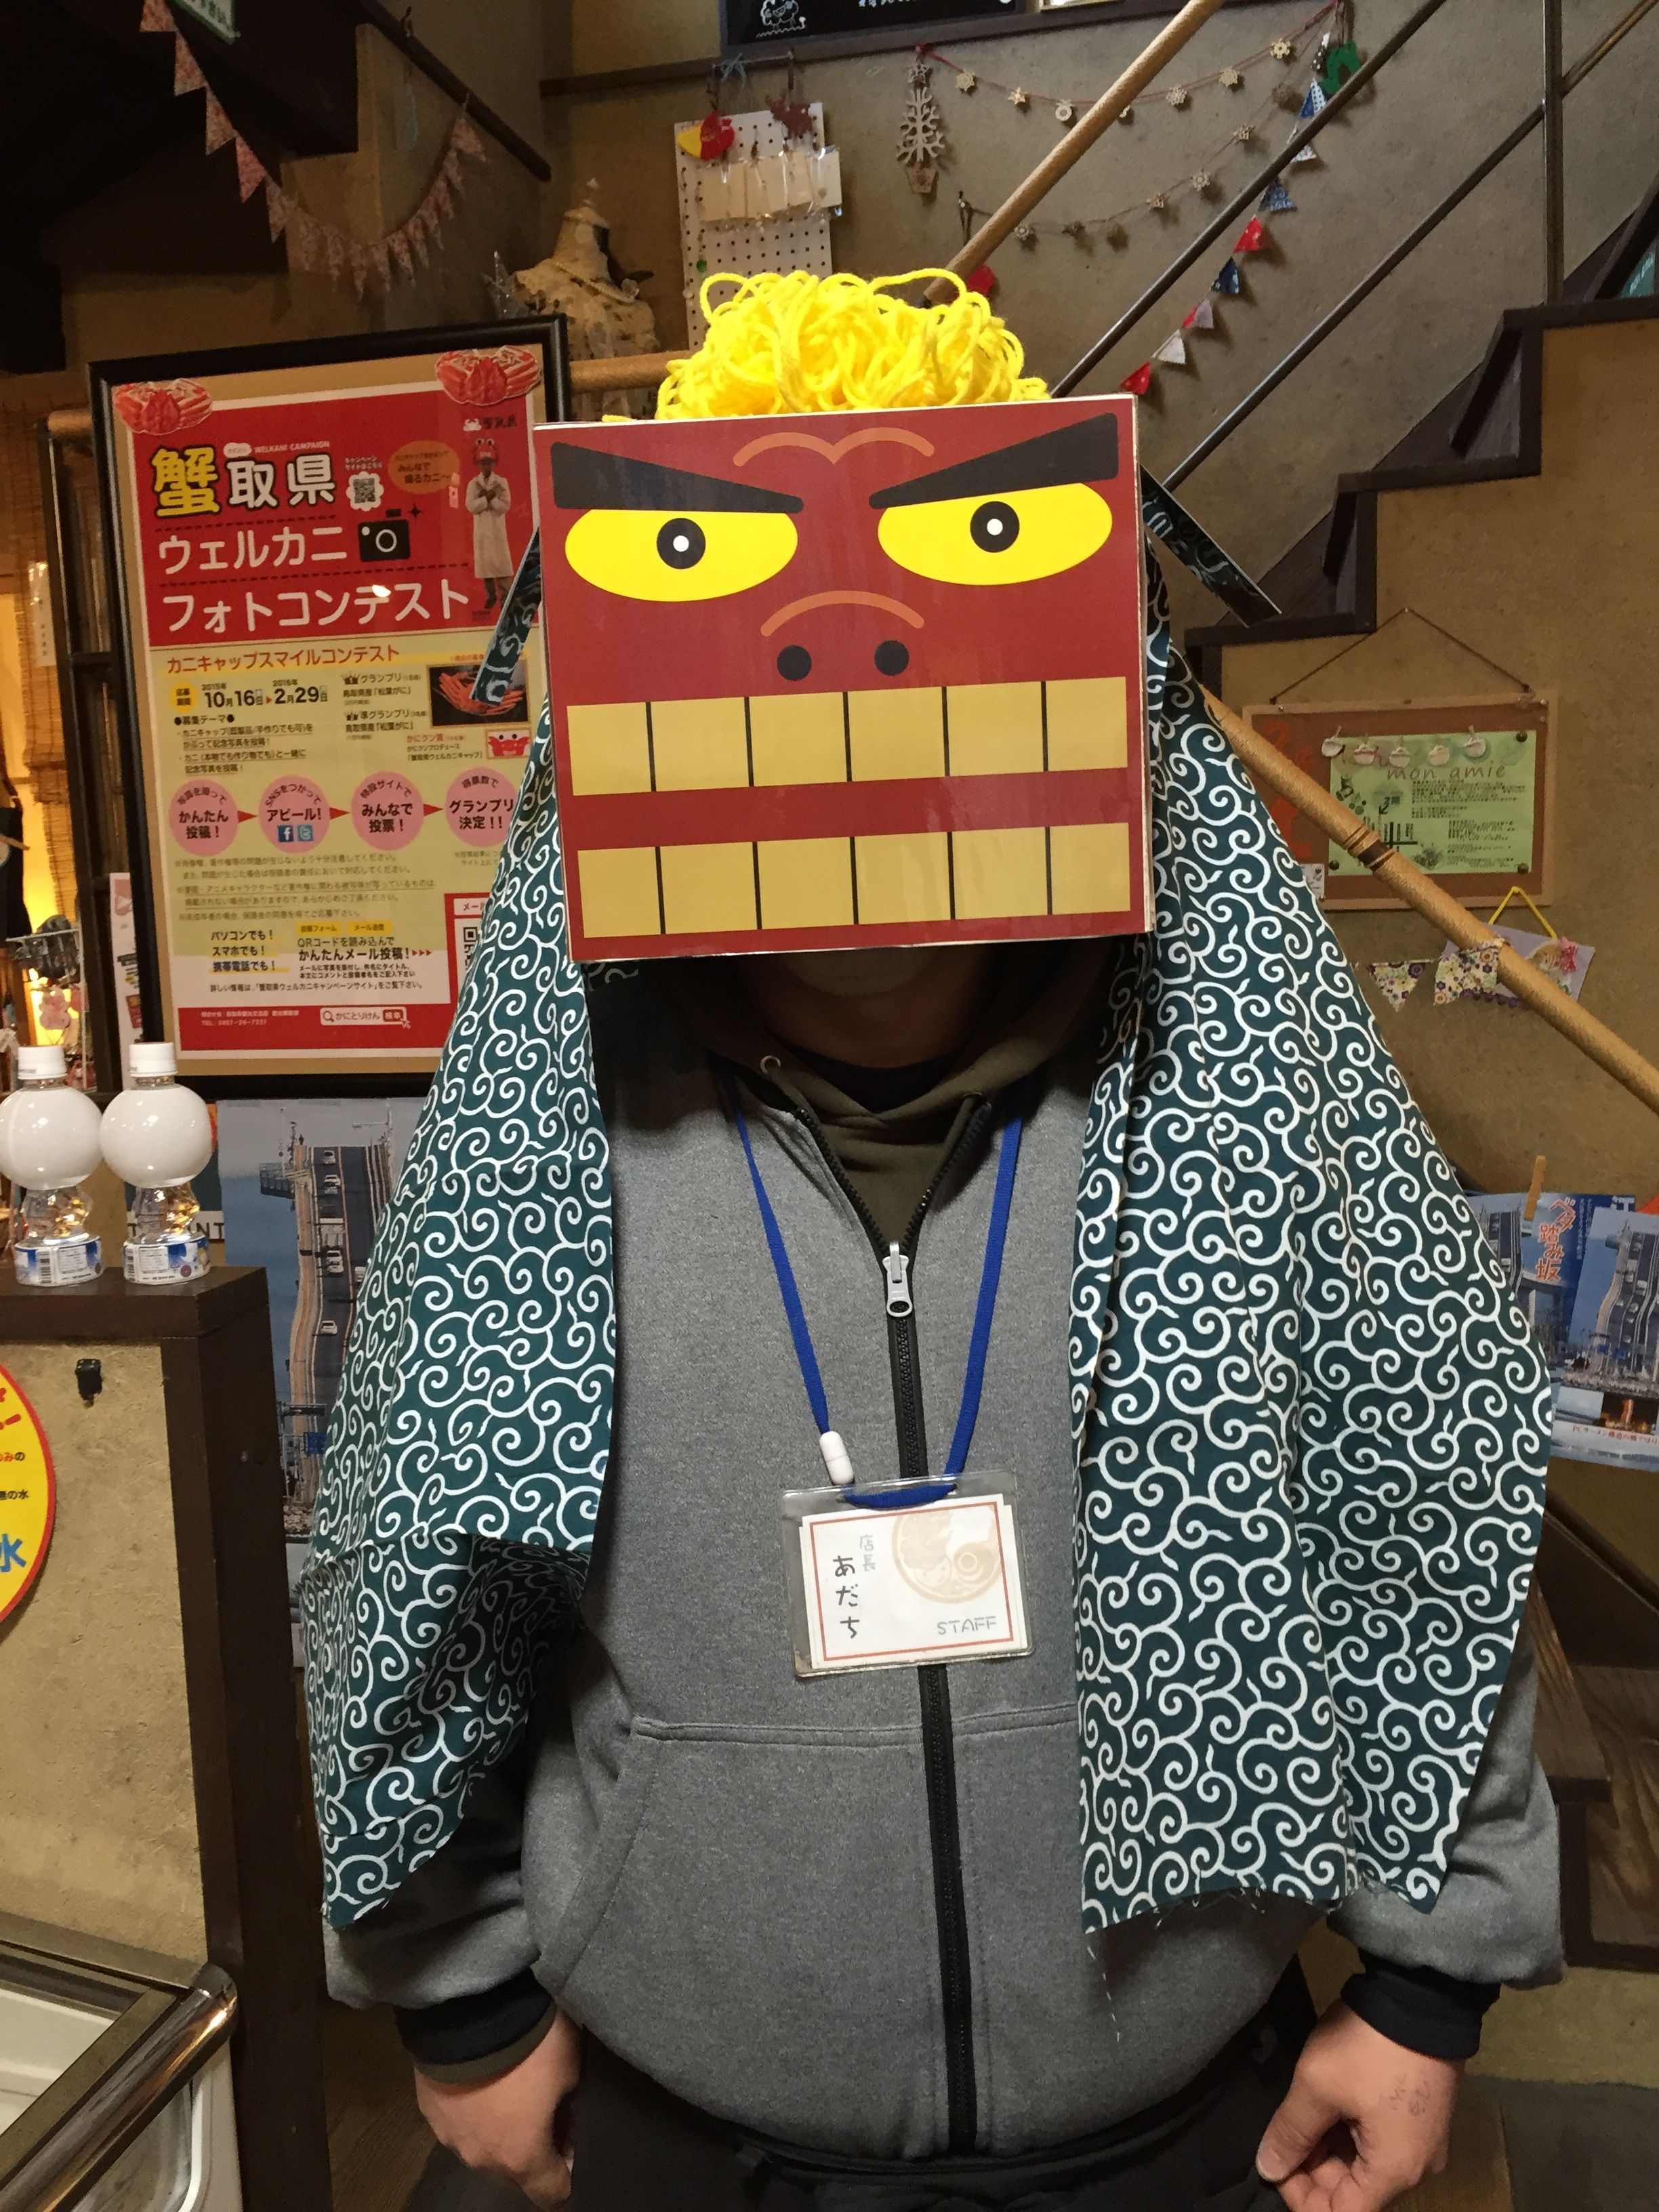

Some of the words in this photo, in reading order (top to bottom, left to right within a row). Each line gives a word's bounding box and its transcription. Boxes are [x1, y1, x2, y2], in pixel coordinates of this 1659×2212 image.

[150, 444, 337, 518] 蟹取県
[159, 525, 348, 574] ウェルカニ
[162, 577, 469, 632] フォトコンテスト
[167, 646, 400, 674] カニキャップスマイルコンテスト
[1387, 767, 1436, 780] mon
[1450, 760, 1506, 779] amie
[265, 783, 322, 808] SNSをつかって
[449, 798, 514, 814] グランプリ
[179, 810, 228, 823] かんたん
[361, 803, 413, 818] みんなで
[298, 937, 394, 947] QRコードを読み込んで
[1535, 1196, 1577, 1282] ベタ踏み坂
[859, 1534, 876, 1572] 店長
[833, 1555, 860, 1639] あだち
[937, 1616, 997, 1636] STAFF
